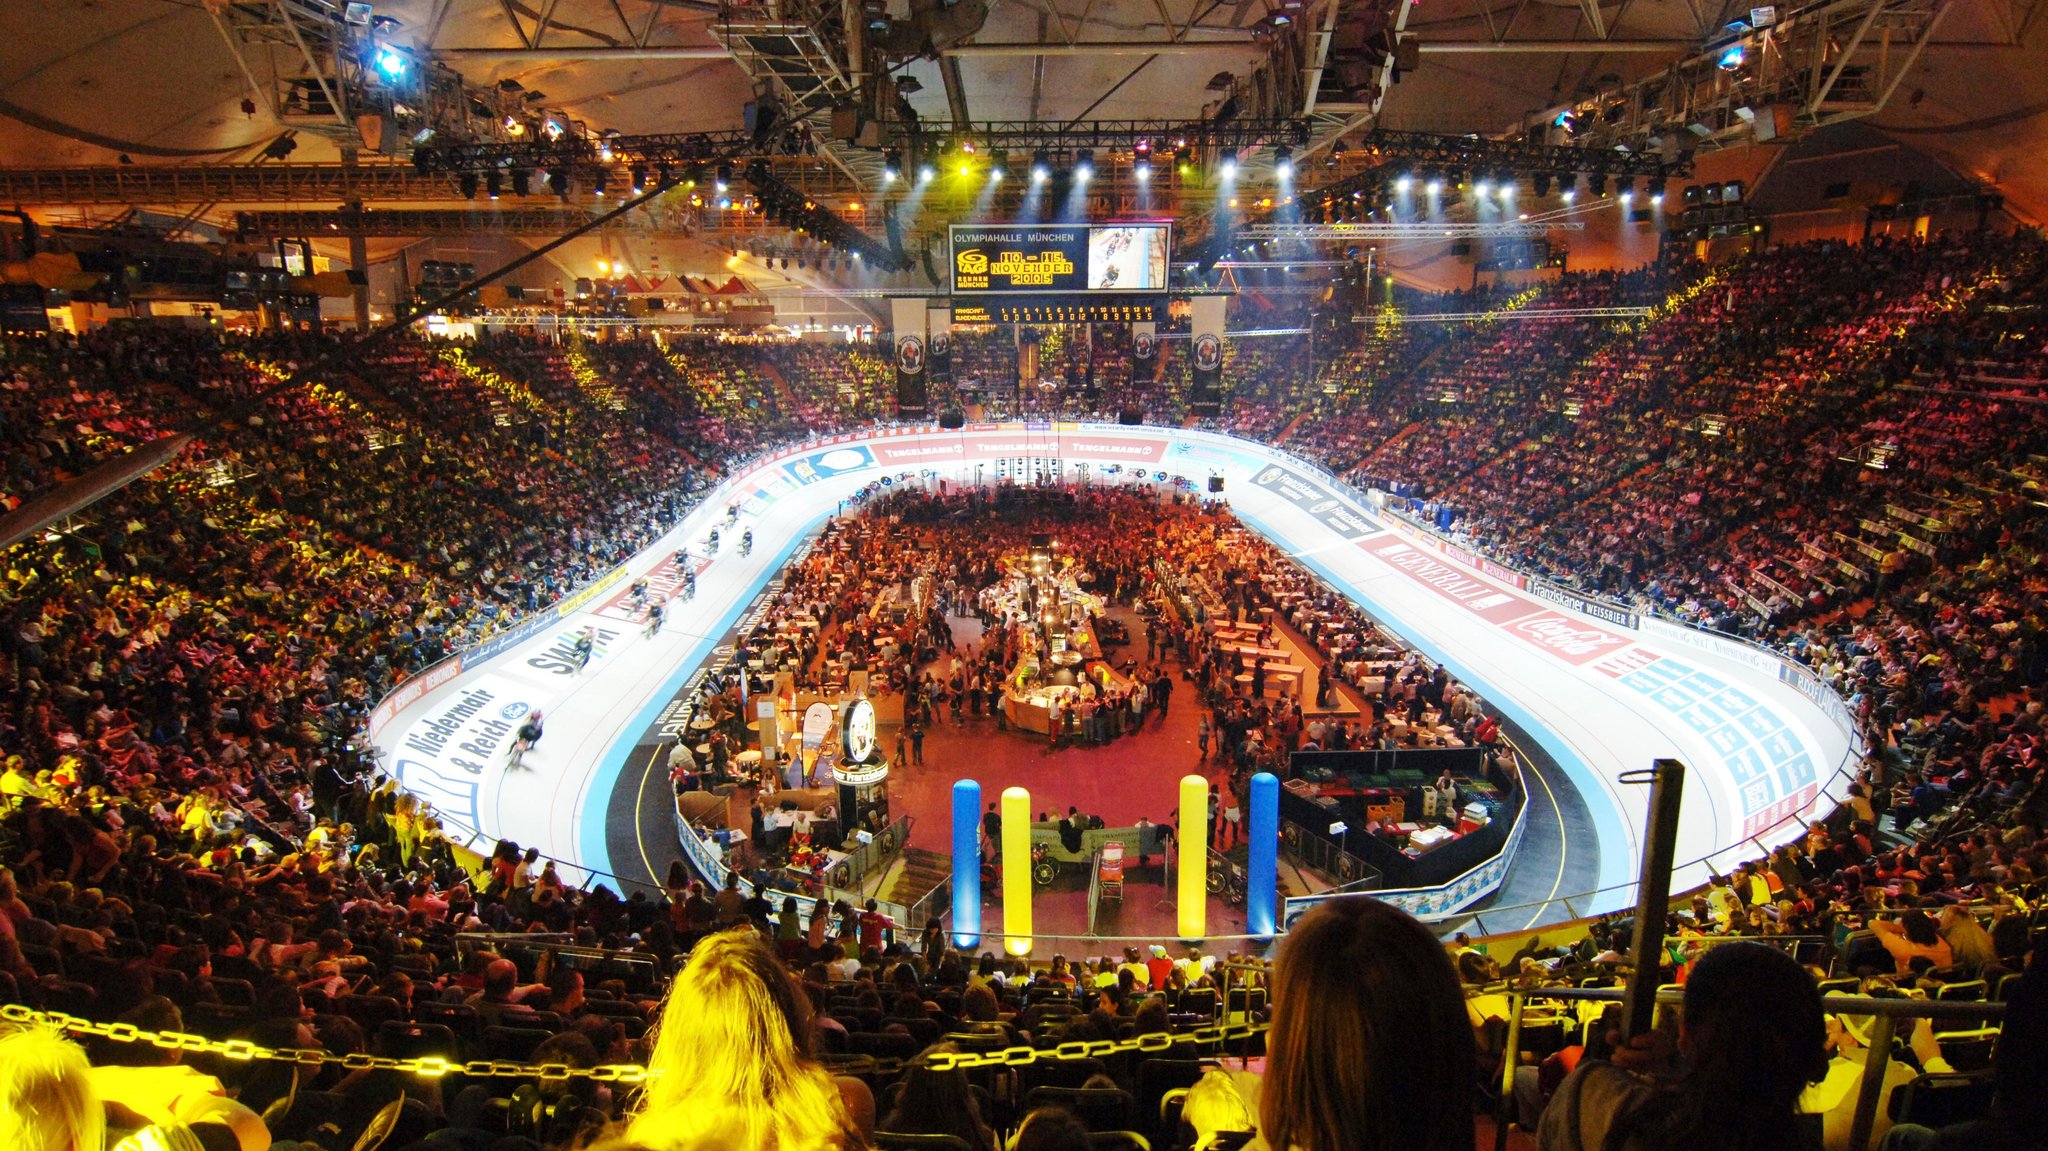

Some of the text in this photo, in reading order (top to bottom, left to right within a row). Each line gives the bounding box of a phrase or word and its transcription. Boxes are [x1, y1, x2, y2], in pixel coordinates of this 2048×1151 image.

[954, 232, 1074, 243] OLYMPIAHALLE MÜNCHEN
[957, 261, 988, 274] TAGE
[991, 262, 1073, 274] NOVEMBER
[1011, 273, 1053, 284] 2005
[885, 445, 954, 458] TENGELMANN
[976, 443, 1048, 452] TENGELMANN
[1072, 443, 1143, 454] TENGELMANN
[1390, 551, 1493, 600] GENERALI
[1486, 563, 1513, 584] GENERALI
[1533, 582, 1626, 625] Franziskaner WEISSBIER
[405, 688, 495, 758] Niedermair
[458, 719, 513, 759] Reich
[450, 757, 483, 775] &
